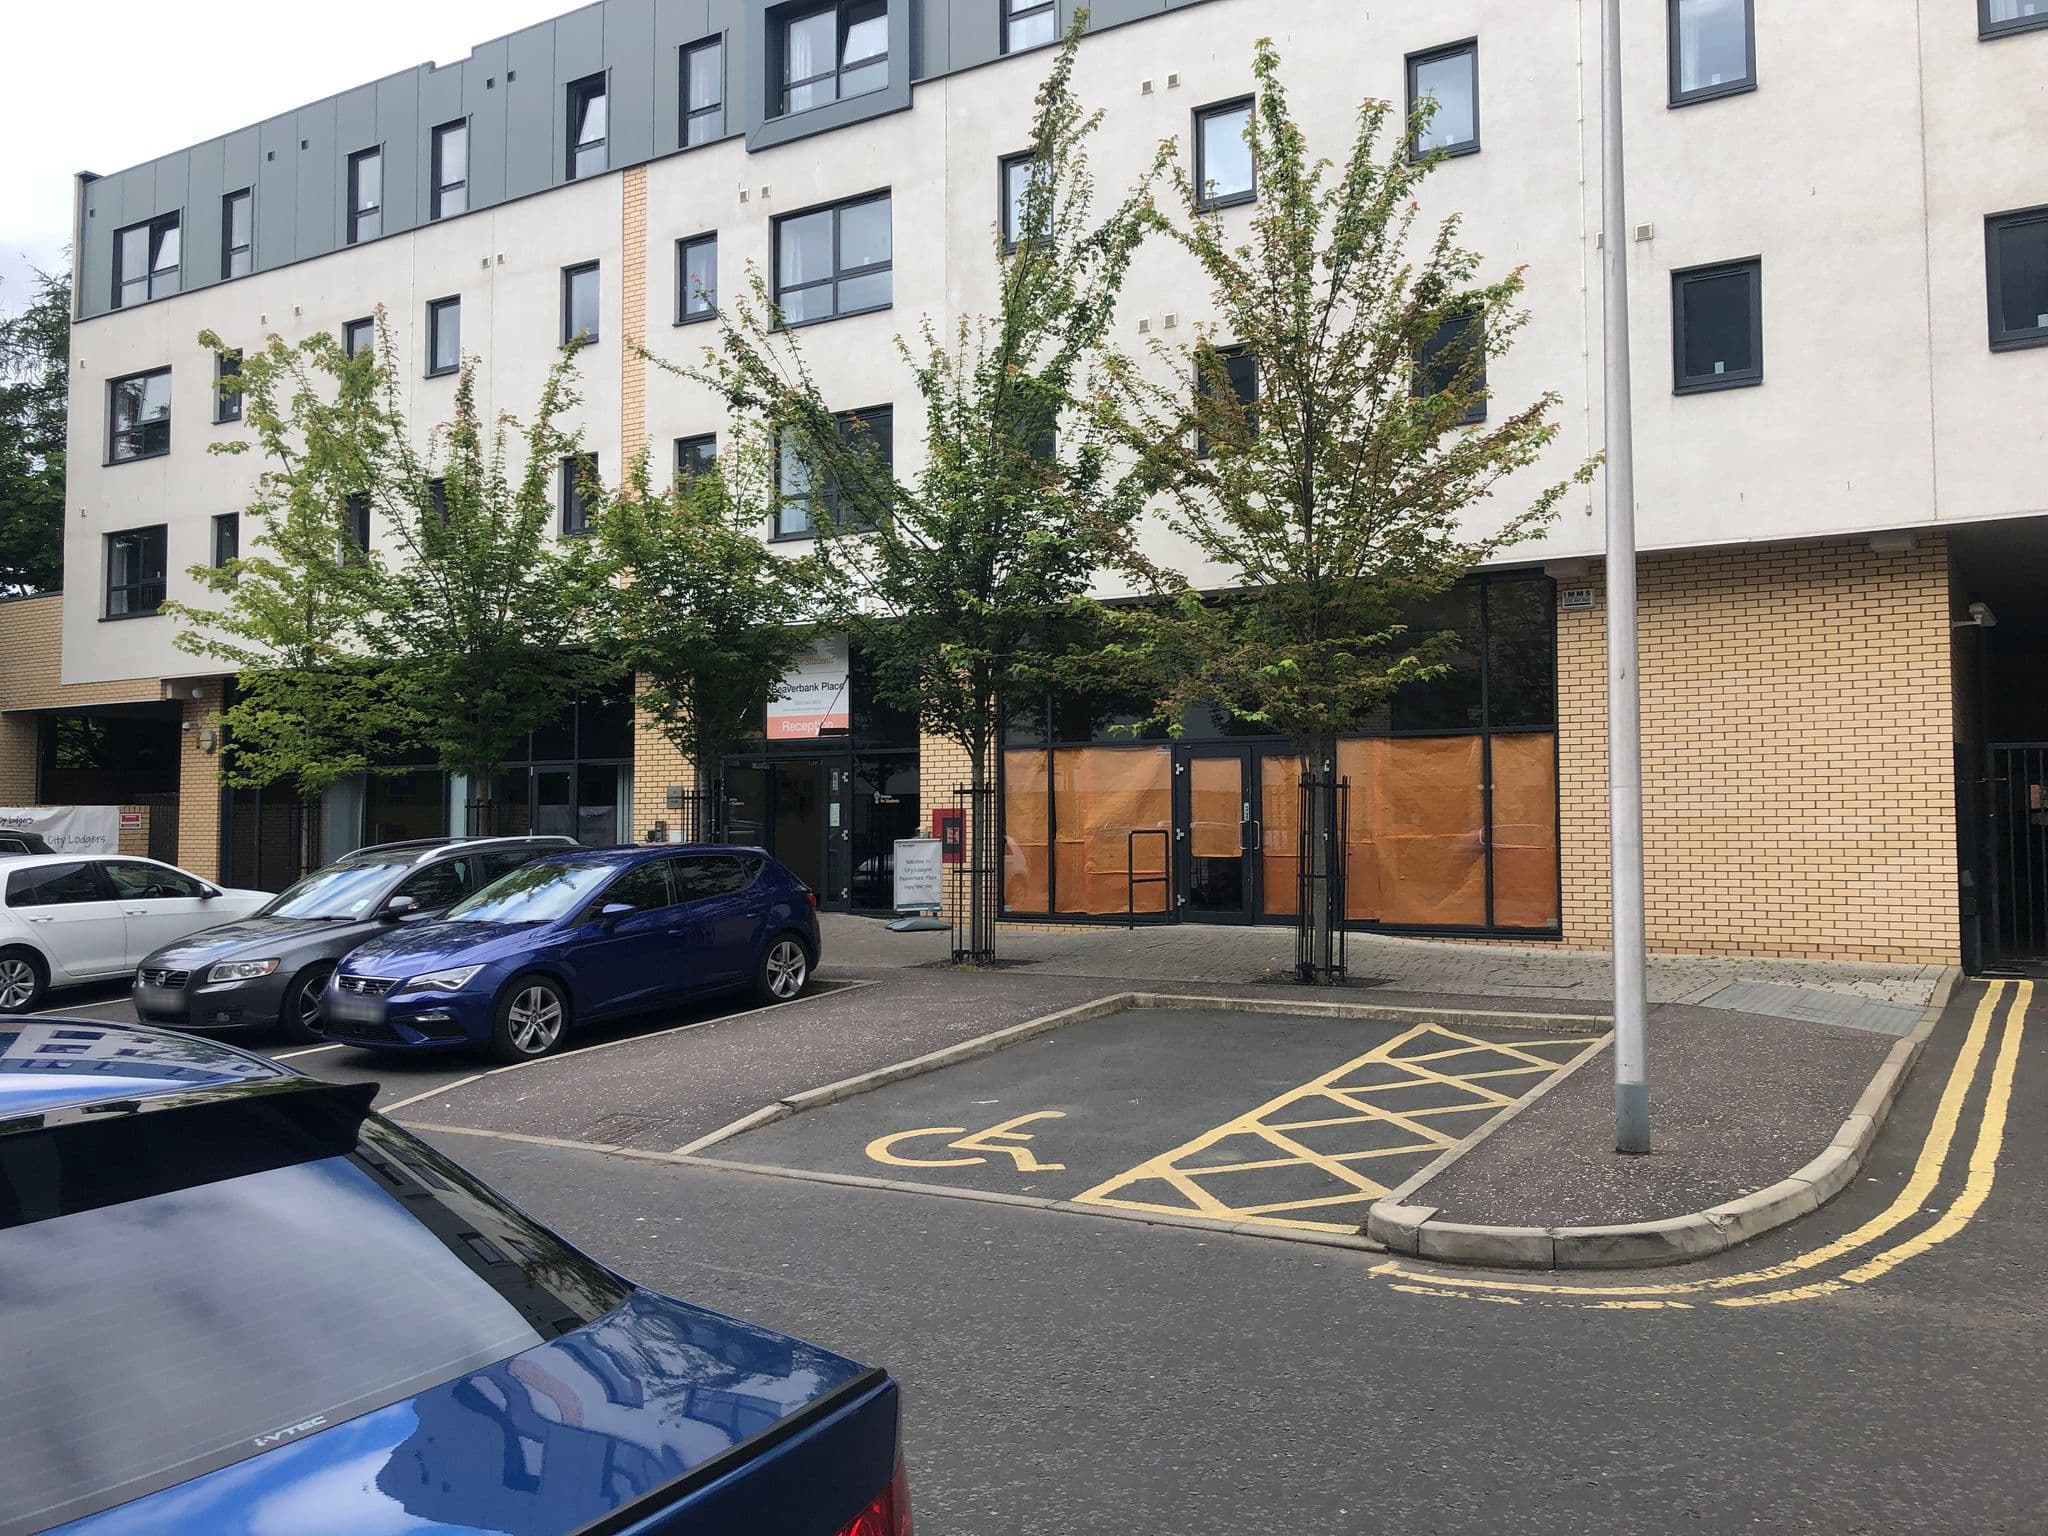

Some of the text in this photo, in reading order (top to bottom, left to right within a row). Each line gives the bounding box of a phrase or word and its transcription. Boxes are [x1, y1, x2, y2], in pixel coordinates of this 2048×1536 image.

[782, 720, 834, 734] Reception
[47, 834, 106, 848] City Lodgers
